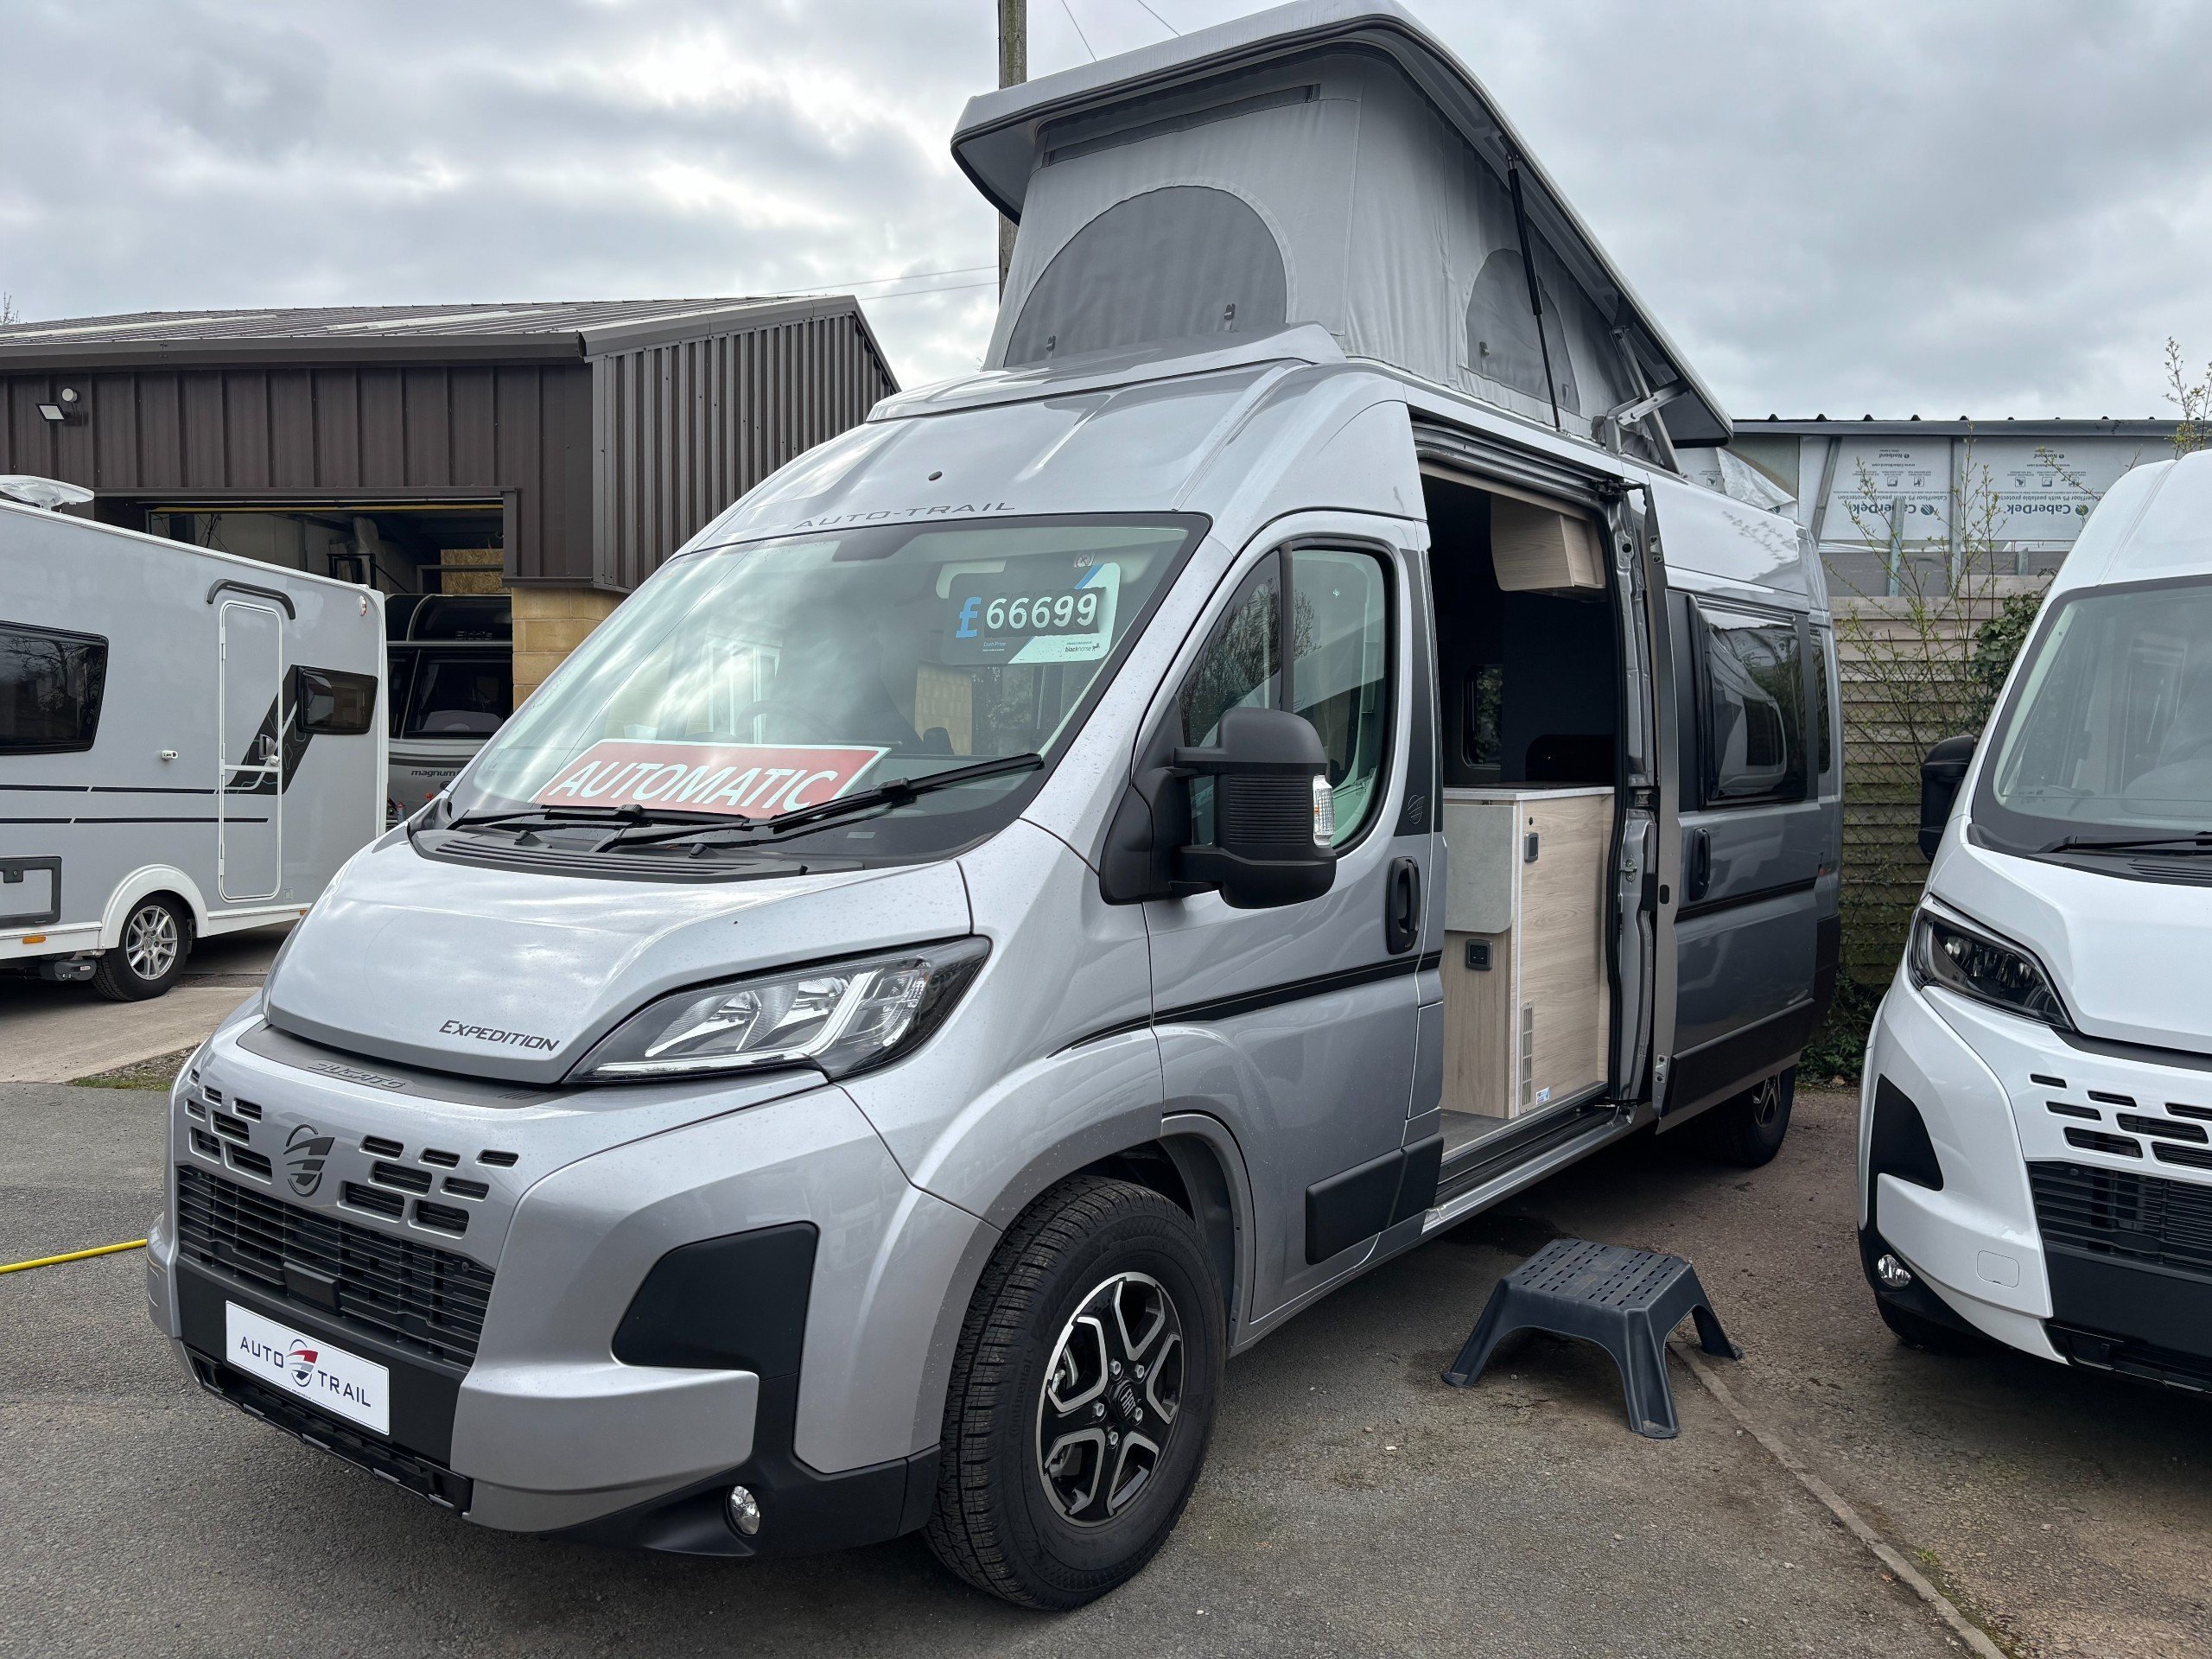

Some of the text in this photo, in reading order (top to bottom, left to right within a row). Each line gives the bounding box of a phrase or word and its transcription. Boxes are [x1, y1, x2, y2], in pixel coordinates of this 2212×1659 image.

[793, 502, 1015, 529] AUTO-TRAIL
[1853, 504, 1916, 515] CaerDek
[2006, 504, 2071, 515] CaberDek
[956, 593, 1097, 639] £66699
[410, 769, 456, 778] magnum
[547, 760, 838, 811] AUTOMATIC
[240, 1336, 372, 1408] AUTO TRAIL
[1120, 1388, 1136, 1417] FIAT
